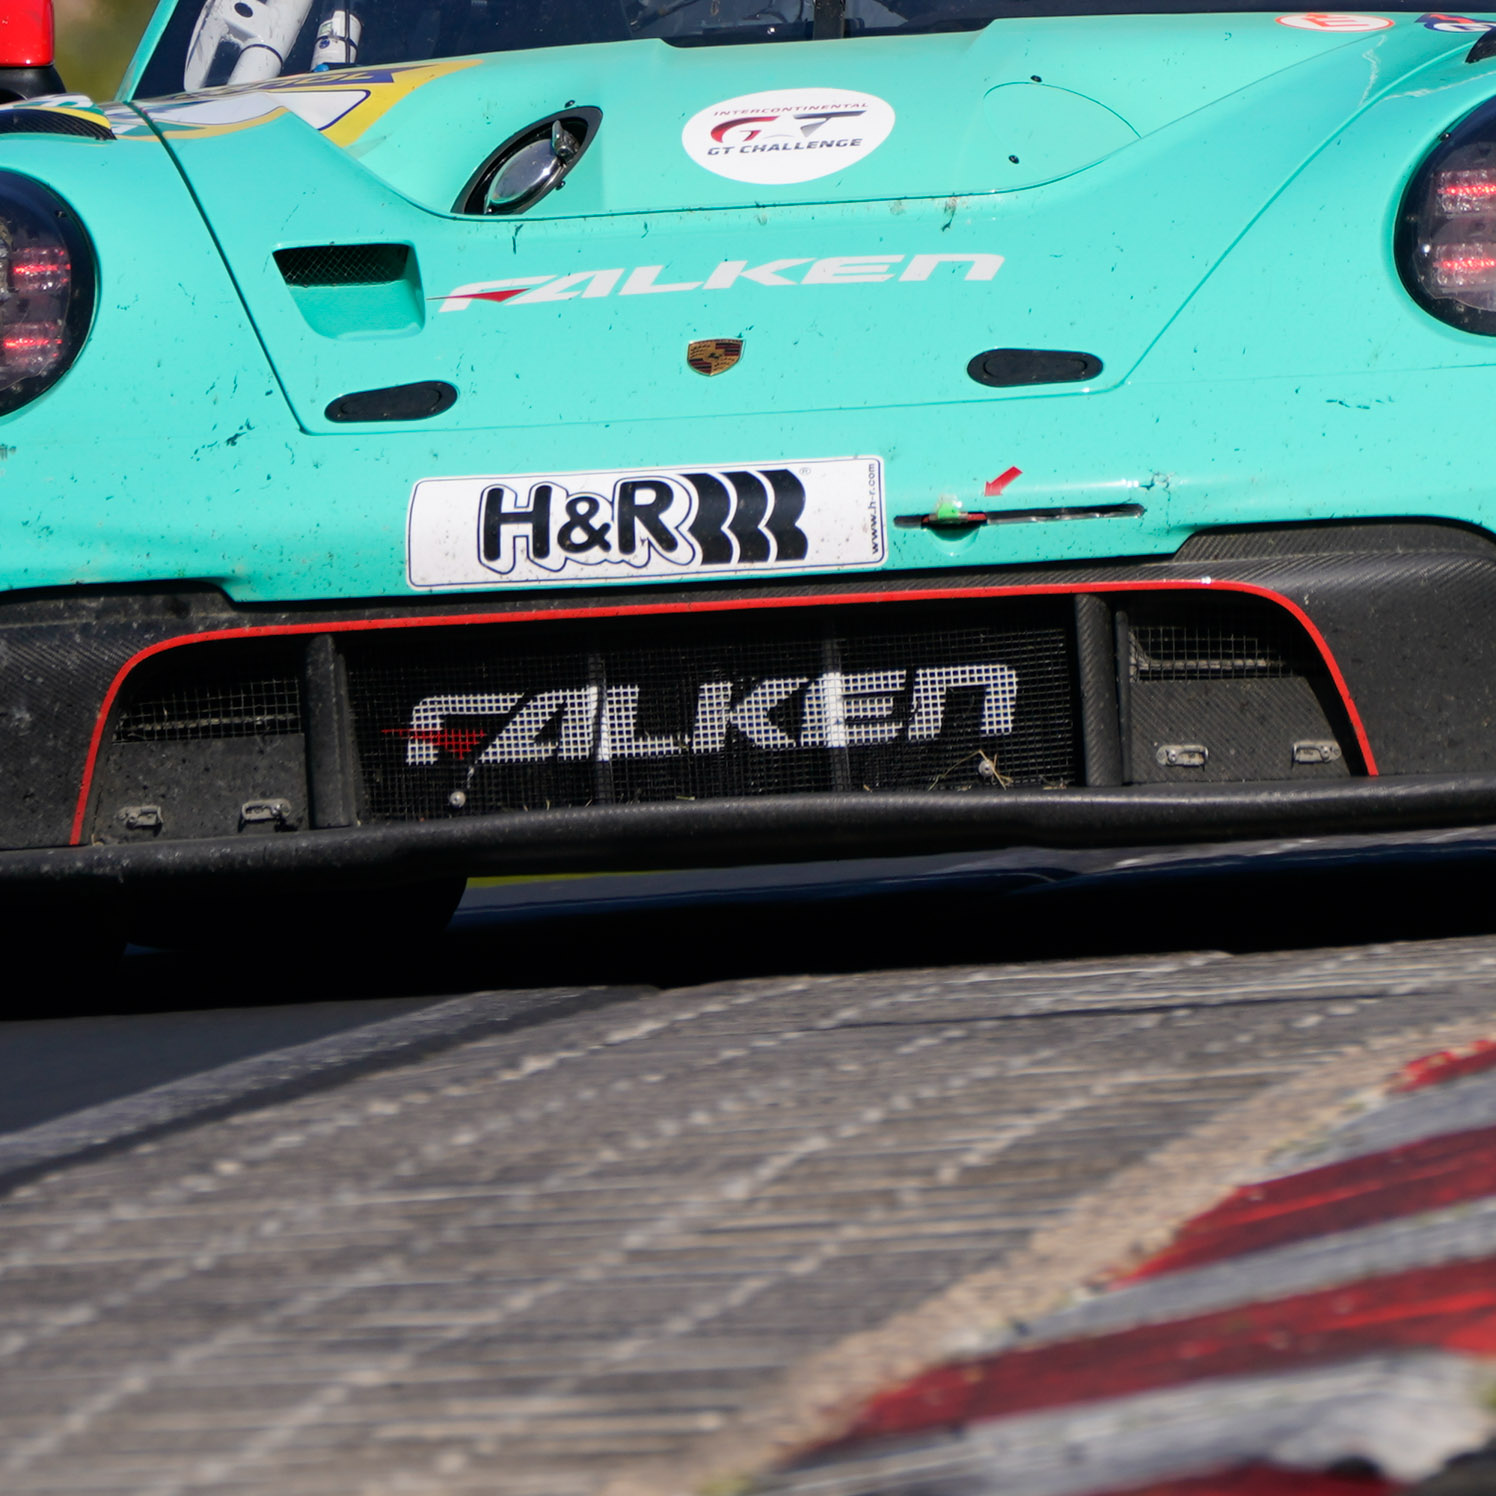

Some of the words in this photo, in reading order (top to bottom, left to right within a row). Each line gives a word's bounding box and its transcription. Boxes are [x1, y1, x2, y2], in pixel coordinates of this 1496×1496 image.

[706, 145, 736, 156] GT
[739, 138, 864, 154] CHALLENGE
[714, 103, 868, 117] INTERCONTINENTAL
[430, 253, 1005, 313] FALKEN
[480, 478, 692, 570] H&R
[867, 463, 879, 555] www.h-r.com
[390, 664, 1018, 765] FALKEN
